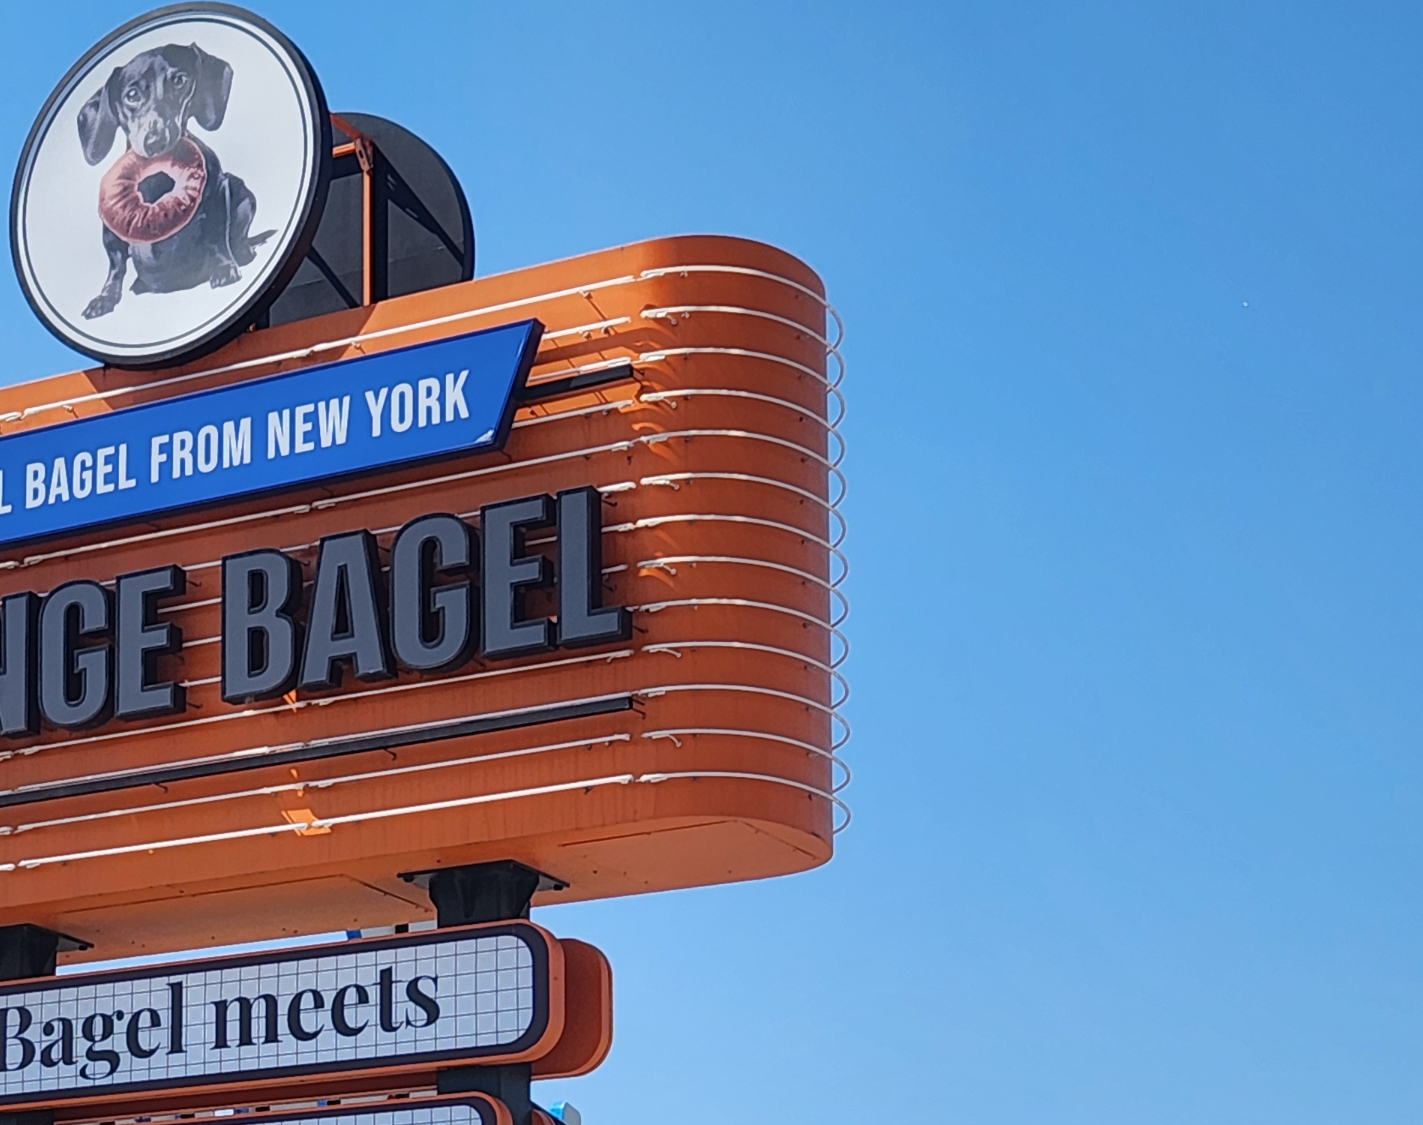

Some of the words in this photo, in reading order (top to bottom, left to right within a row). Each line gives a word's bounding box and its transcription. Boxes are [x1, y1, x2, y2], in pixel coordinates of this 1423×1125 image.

[24, 442, 137, 510] BAGEL
[149, 418, 253, 481] FROM
[266, 394, 351, 458] NEW
[364, 369, 471, 438] YORK
[221, 484, 632, 705] BAGEL
[209, 966, 441, 1051] meets
